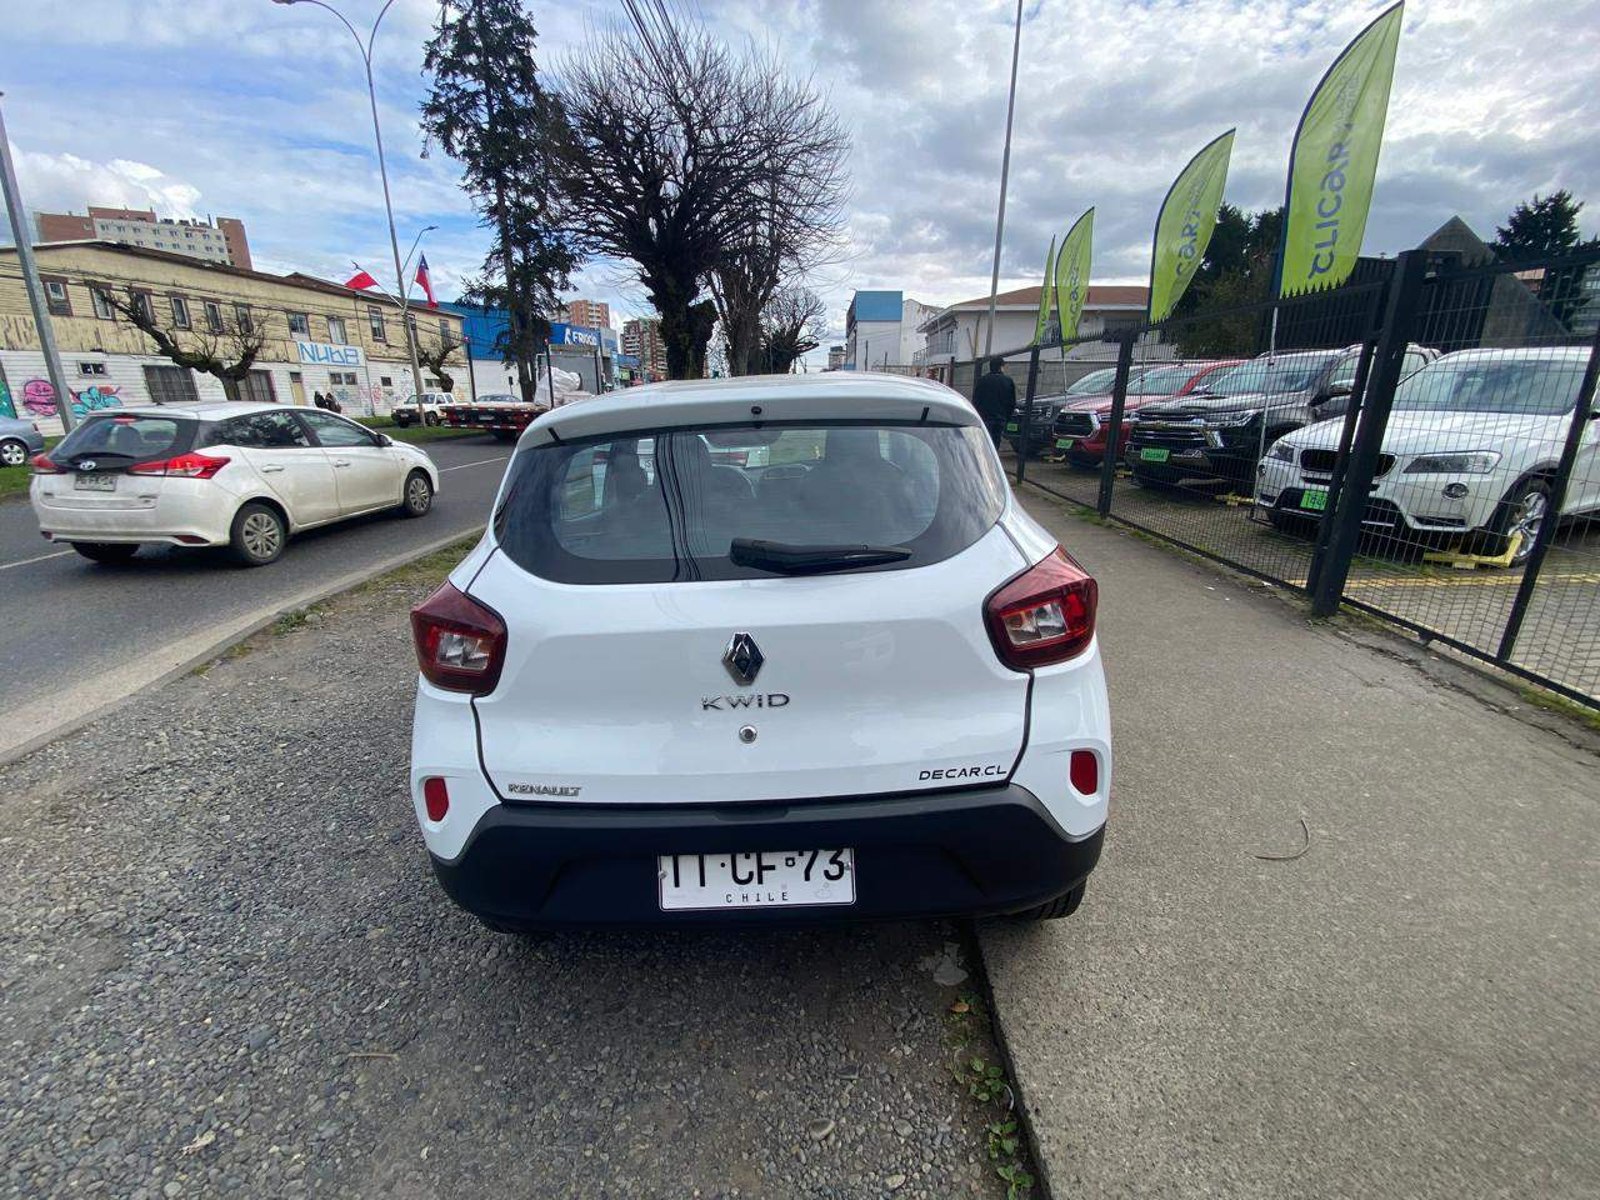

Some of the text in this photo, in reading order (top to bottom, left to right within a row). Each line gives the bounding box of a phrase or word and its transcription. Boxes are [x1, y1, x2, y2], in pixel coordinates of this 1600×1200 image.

[918, 764, 1008, 781] DECAR.CL
[508, 783, 582, 797] RENAULT
[725, 891, 789, 904] CHILE
